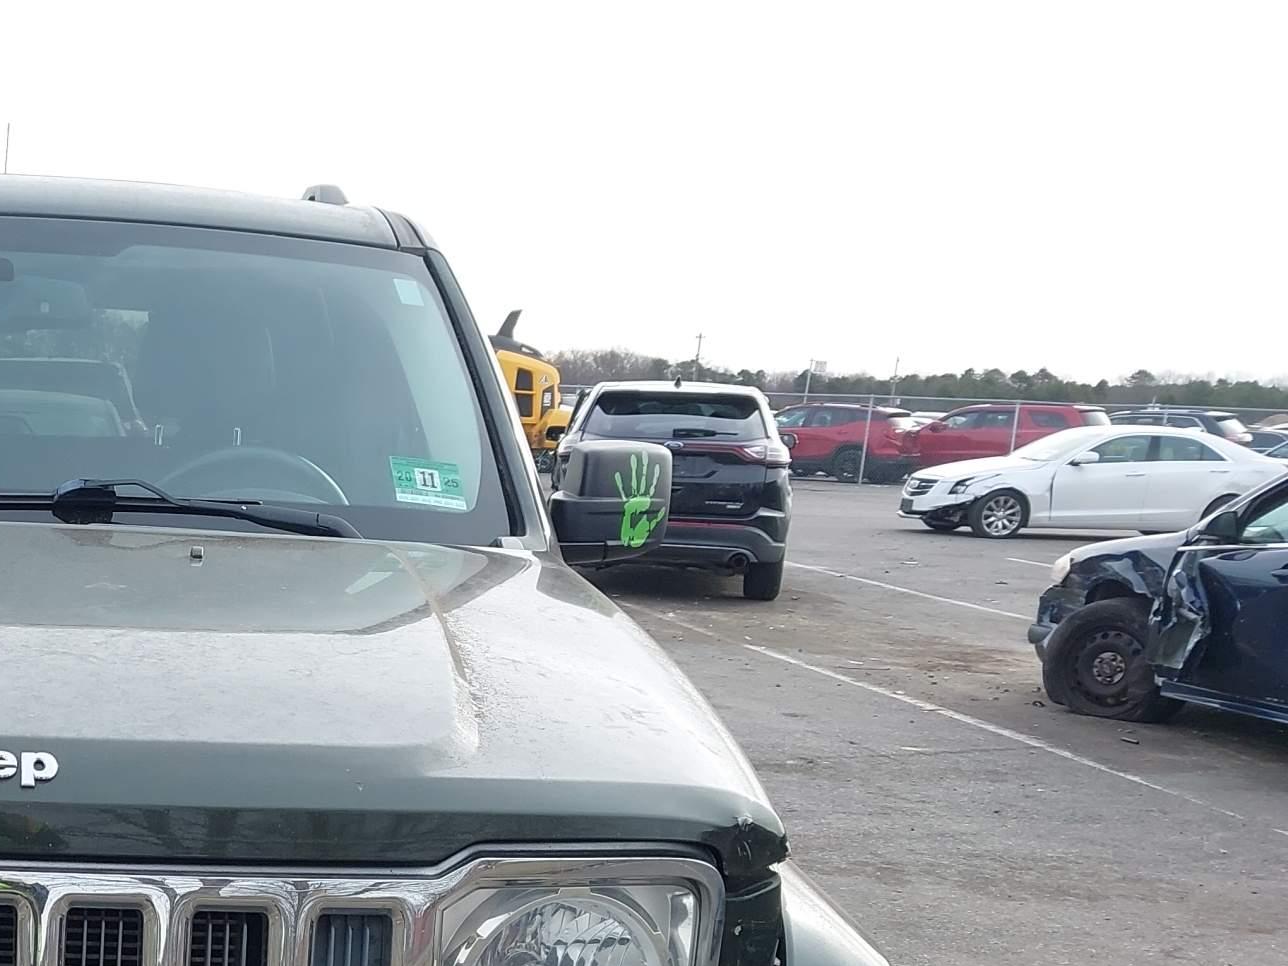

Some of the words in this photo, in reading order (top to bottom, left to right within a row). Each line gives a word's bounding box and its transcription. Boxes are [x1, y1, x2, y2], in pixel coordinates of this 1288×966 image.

[397, 470, 412, 482] 20
[419, 471, 438, 489] 11
[442, 476, 460, 488] 25
